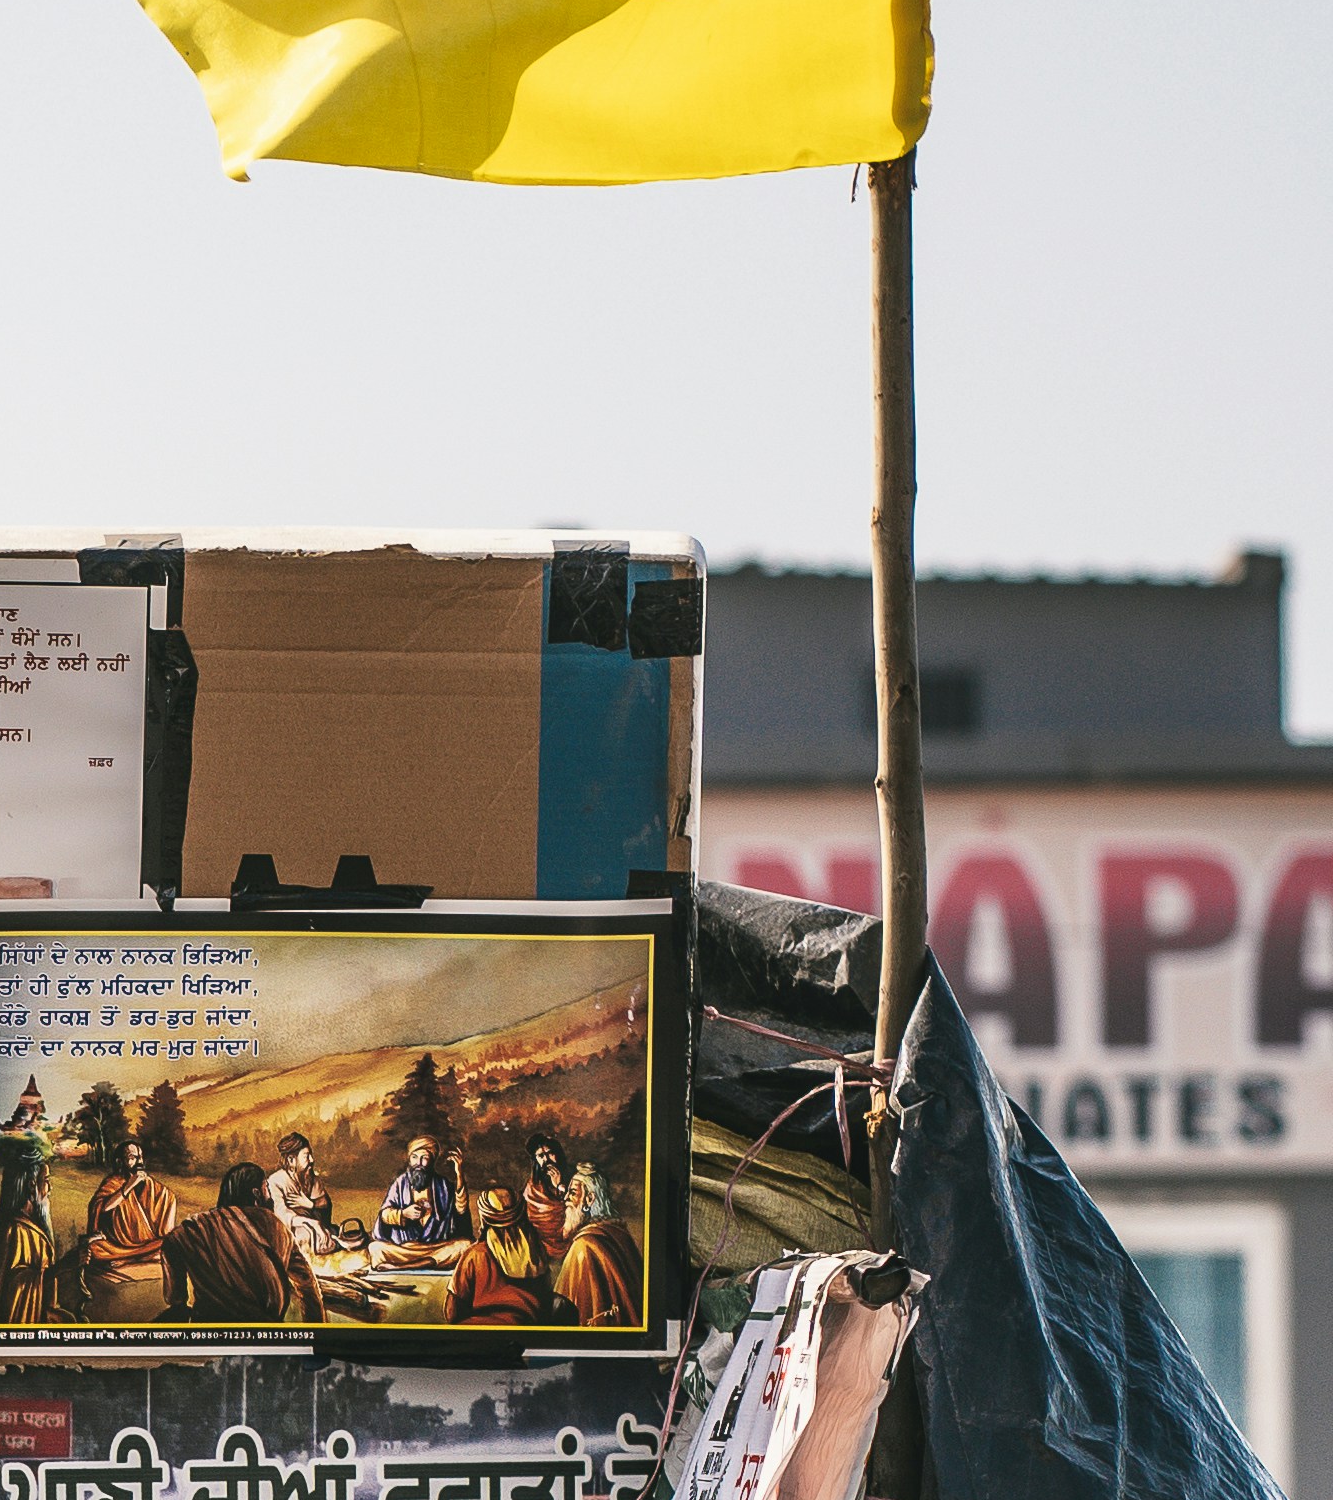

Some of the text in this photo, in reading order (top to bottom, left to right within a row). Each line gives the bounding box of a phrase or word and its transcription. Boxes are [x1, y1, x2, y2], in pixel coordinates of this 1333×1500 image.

[0, 944, 45, 964] ਸਿੱਧਾਂ
[51, 943, 68, 964] ਦੇ
[75, 949, 115, 964] ਨਾਲ
[122, 950, 176, 964] ਨਾਨਕ
[735, 846, 1333, 1048] APA
[29, 974, 51, 998] ਹੀ
[58, 975, 94, 998] ਫੁੱਲ
[101, 974, 174, 995] ਮਹਿਕਦਾ
[40, 1011, 91, 1026] ਰਾਕਸ਼
[100, 1006, 121, 1026] ਤੋਂ
[41, 1041, 64, 1056] ਦਾ
[71, 1041, 125, 1056] ਨਾਨਕ
[1023, 1073, 1290, 1145] IATES
